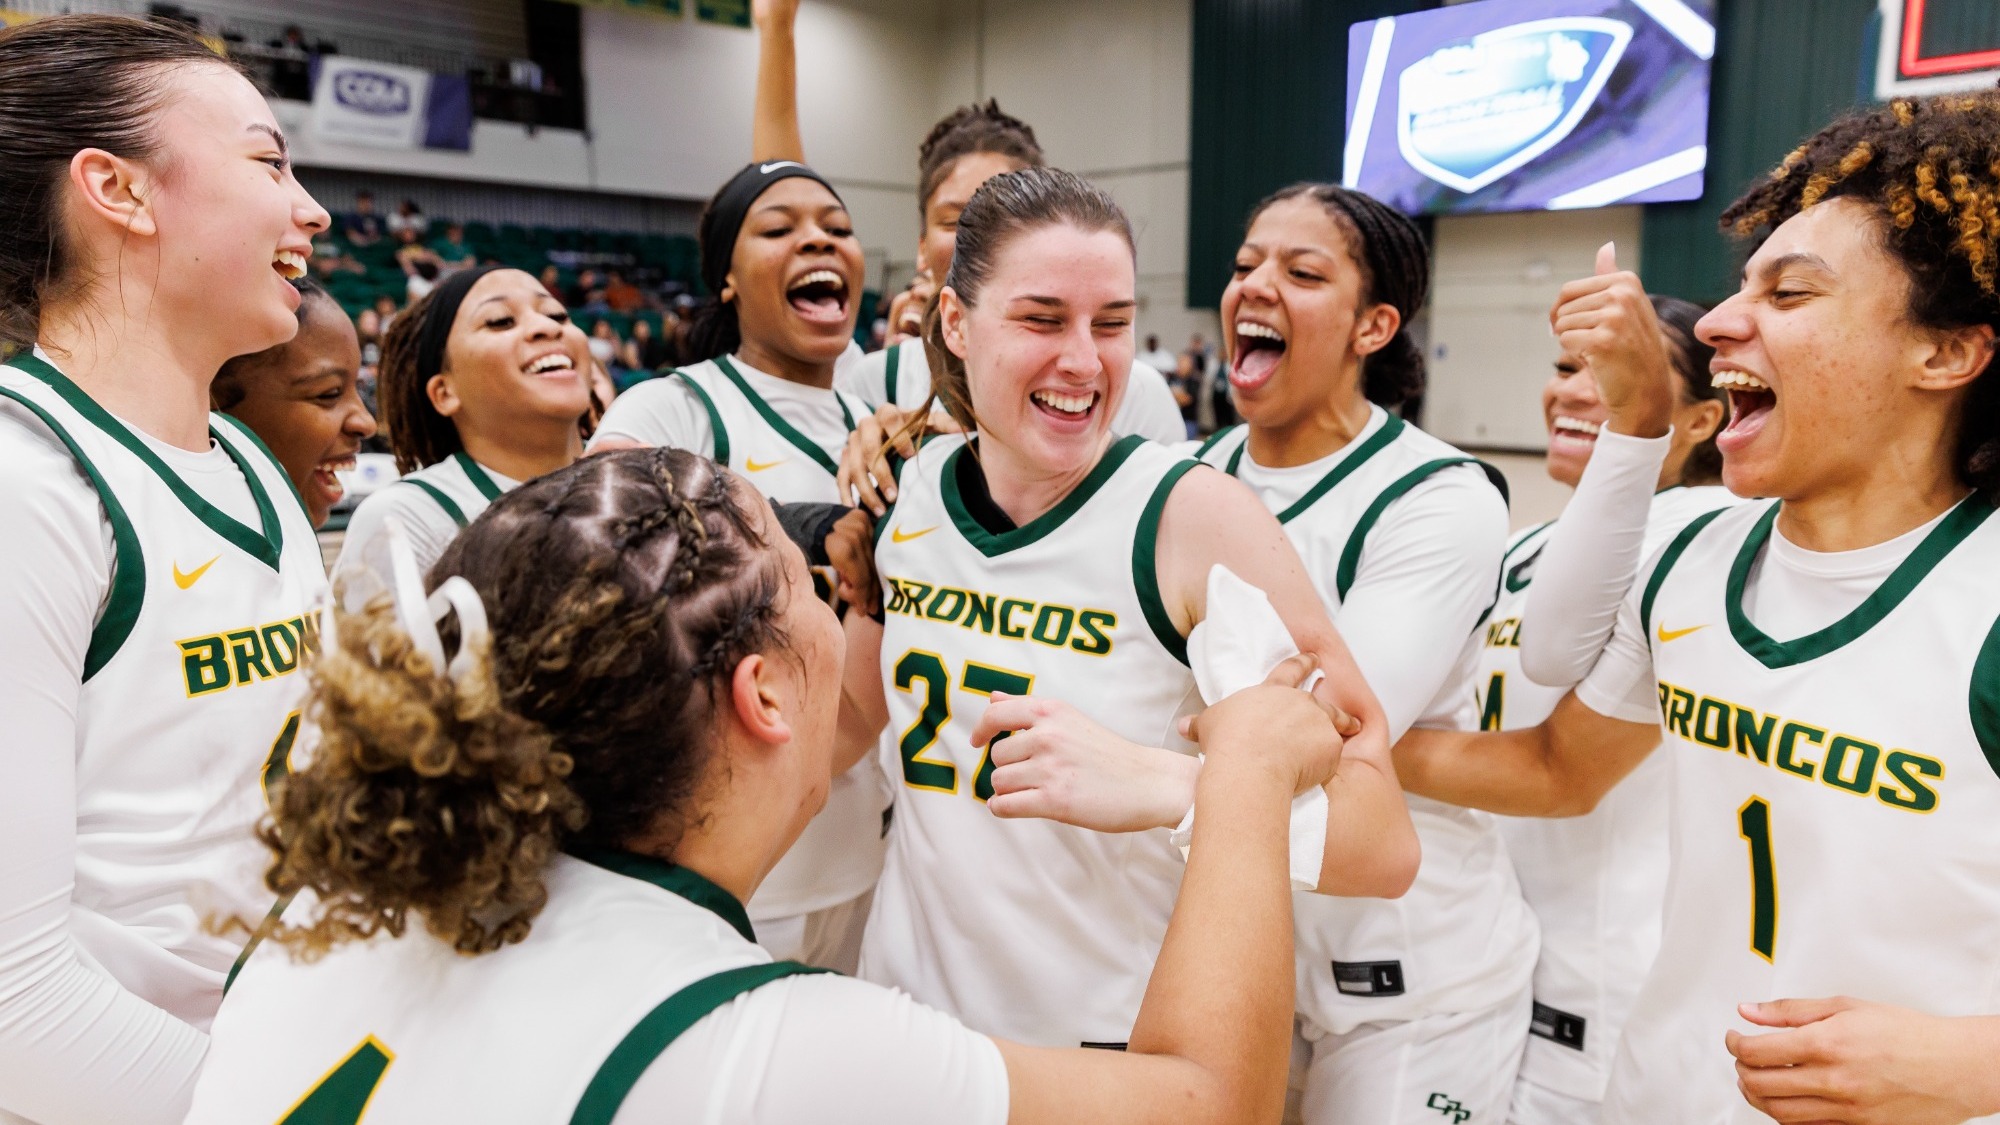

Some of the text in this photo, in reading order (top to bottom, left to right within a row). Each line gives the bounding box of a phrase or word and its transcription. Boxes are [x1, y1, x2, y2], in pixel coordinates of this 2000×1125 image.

[1737, 794, 1779, 965] 1
[1381, 970, 1393, 987] L
[1426, 1092, 1472, 1125] CPP
